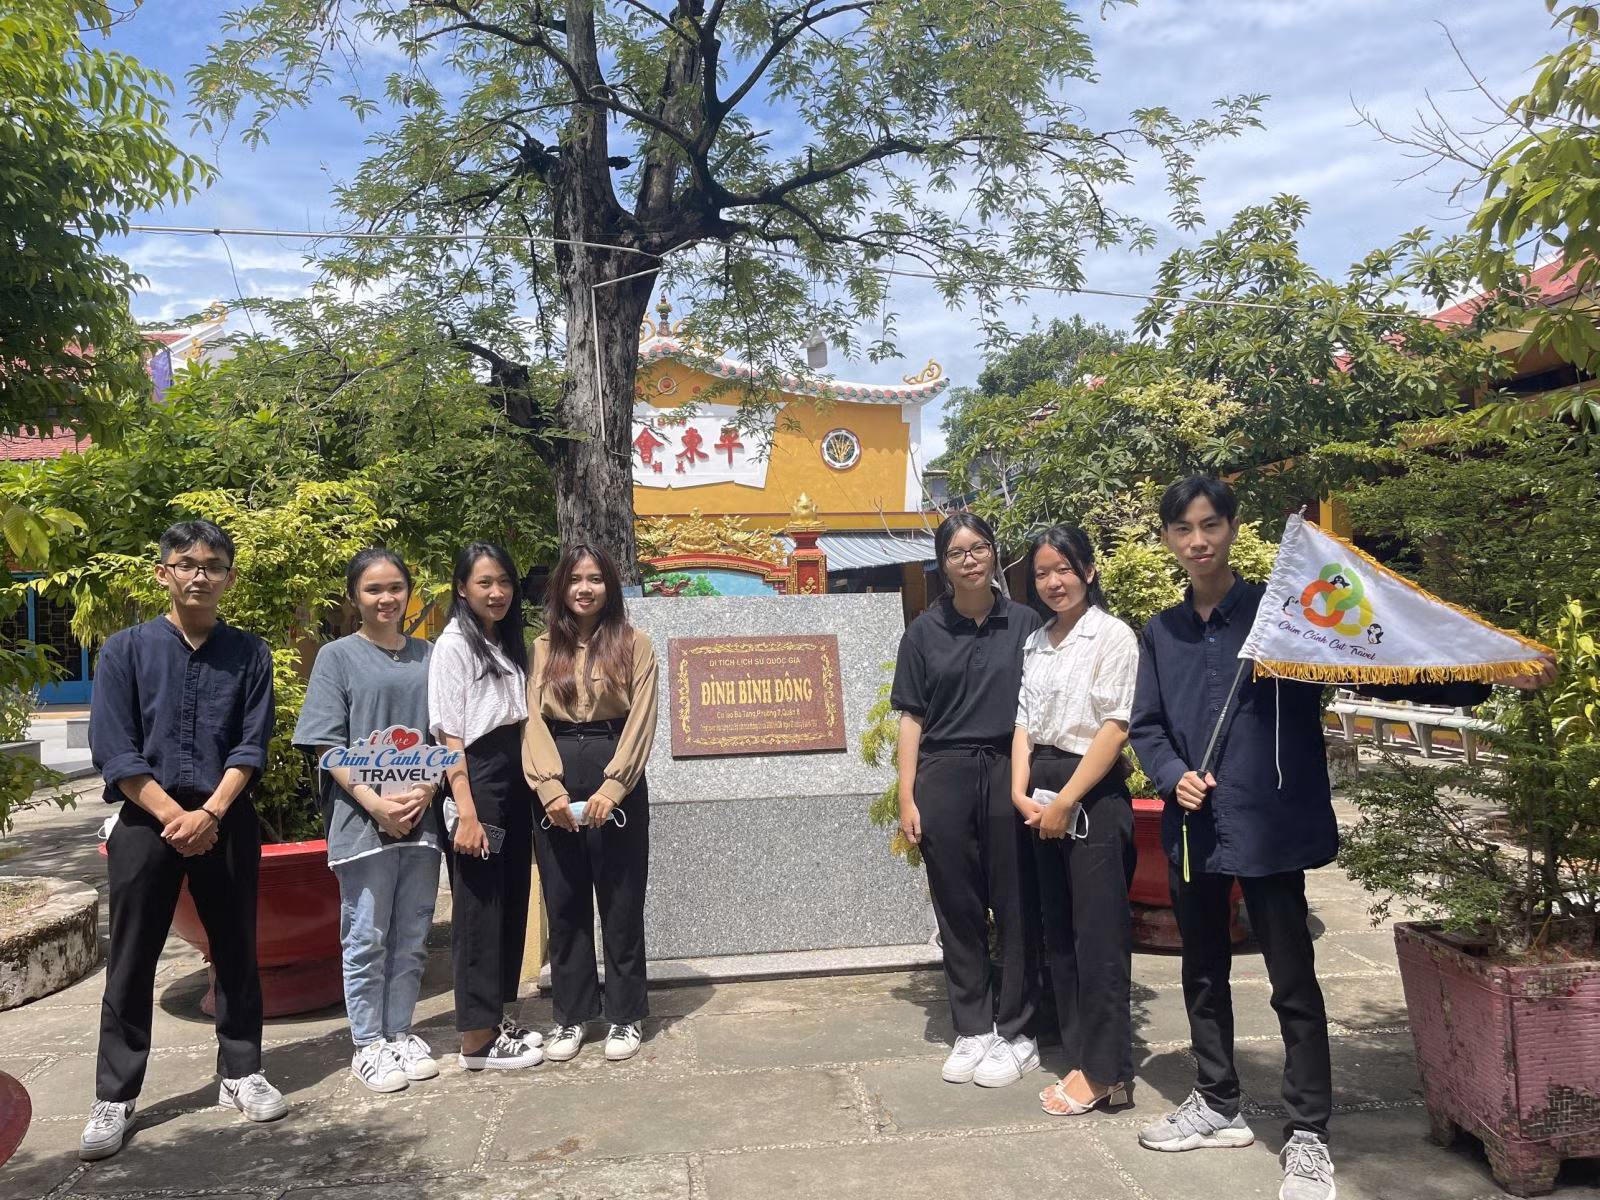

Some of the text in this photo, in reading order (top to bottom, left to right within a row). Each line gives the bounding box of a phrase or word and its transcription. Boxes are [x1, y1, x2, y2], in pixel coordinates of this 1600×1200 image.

[1278, 620, 1301, 634] Chim
[1328, 639, 1346, 651] Cụt
[1349, 645, 1377, 661] Travel
[701, 670, 813, 706] ĐÌNH BÌNH ĐÔNG
[381, 731, 410, 746] love
[322, 748, 370, 769] Chim
[425, 747, 459, 768] Cụt
[359, 768, 431, 782] TRAVEL
